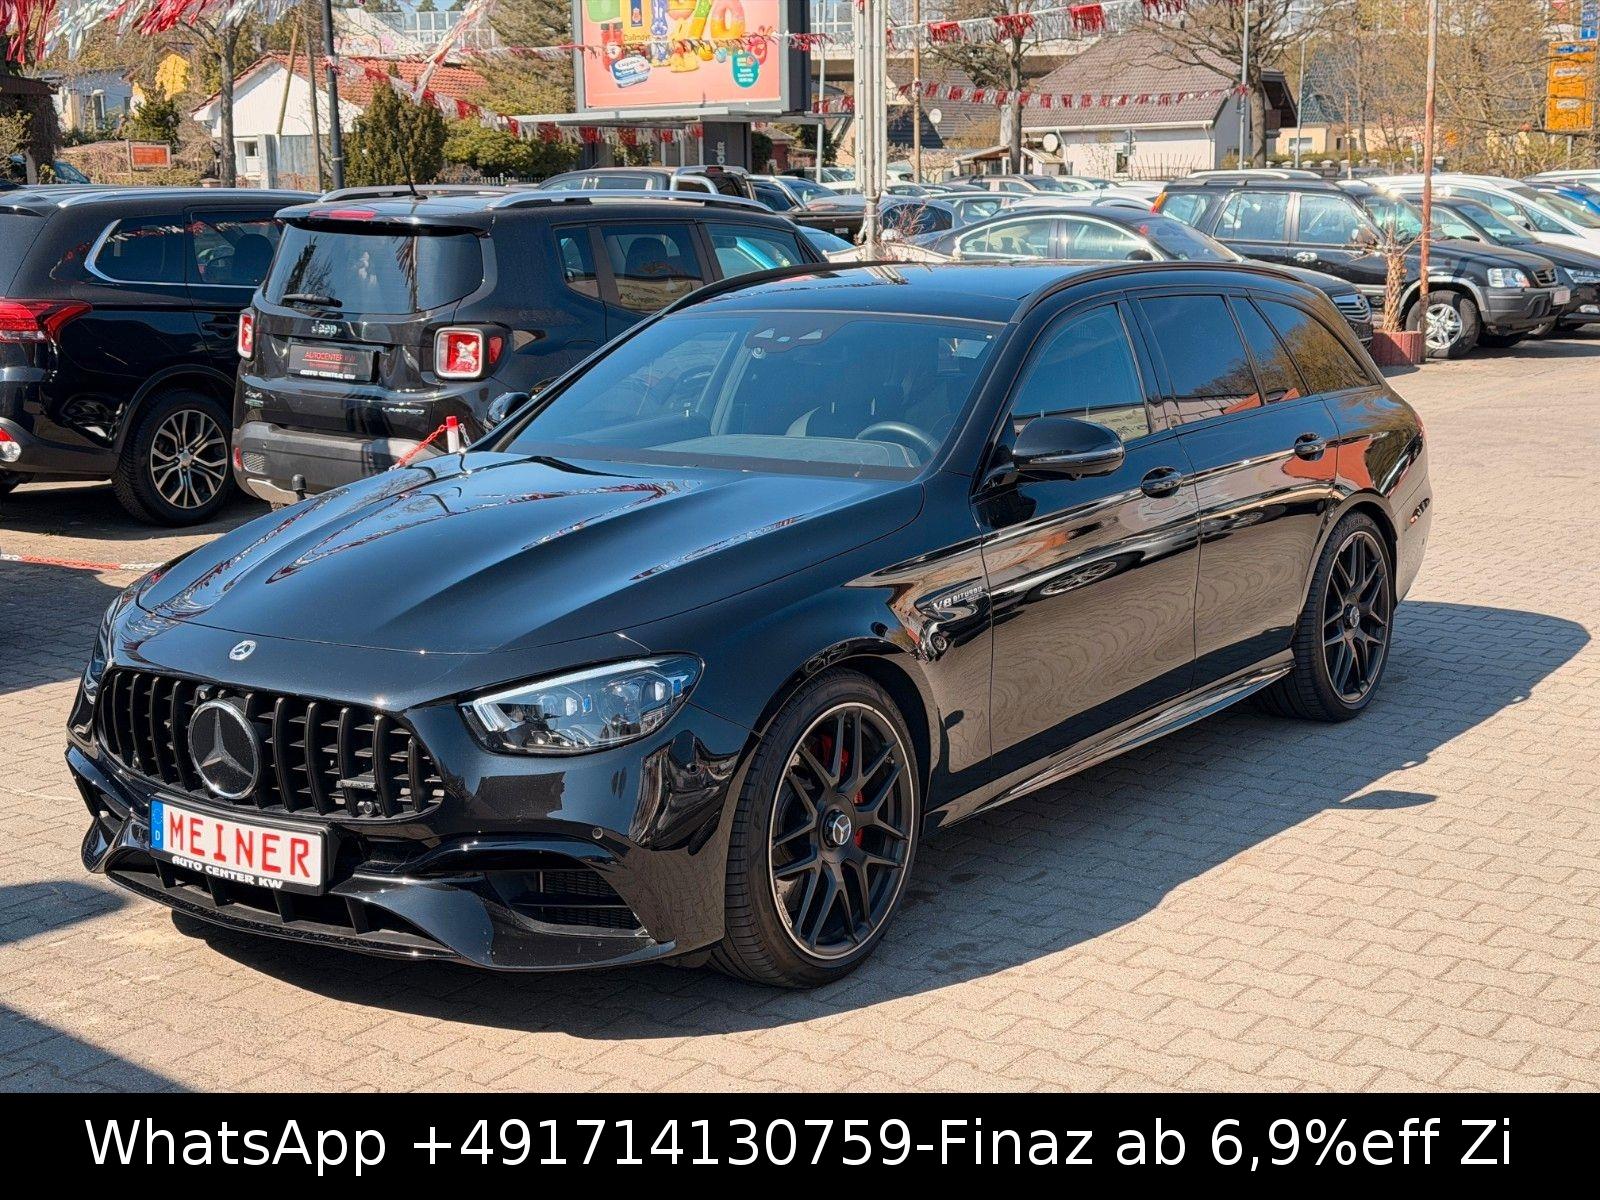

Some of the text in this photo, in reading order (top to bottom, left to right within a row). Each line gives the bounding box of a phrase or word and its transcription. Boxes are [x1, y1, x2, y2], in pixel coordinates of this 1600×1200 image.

[311, 320, 338, 337] Jeep
[933, 597, 952, 610] V8
[154, 811, 311, 878] D MEINER
[171, 855, 284, 890] AUTO CENTER KW
